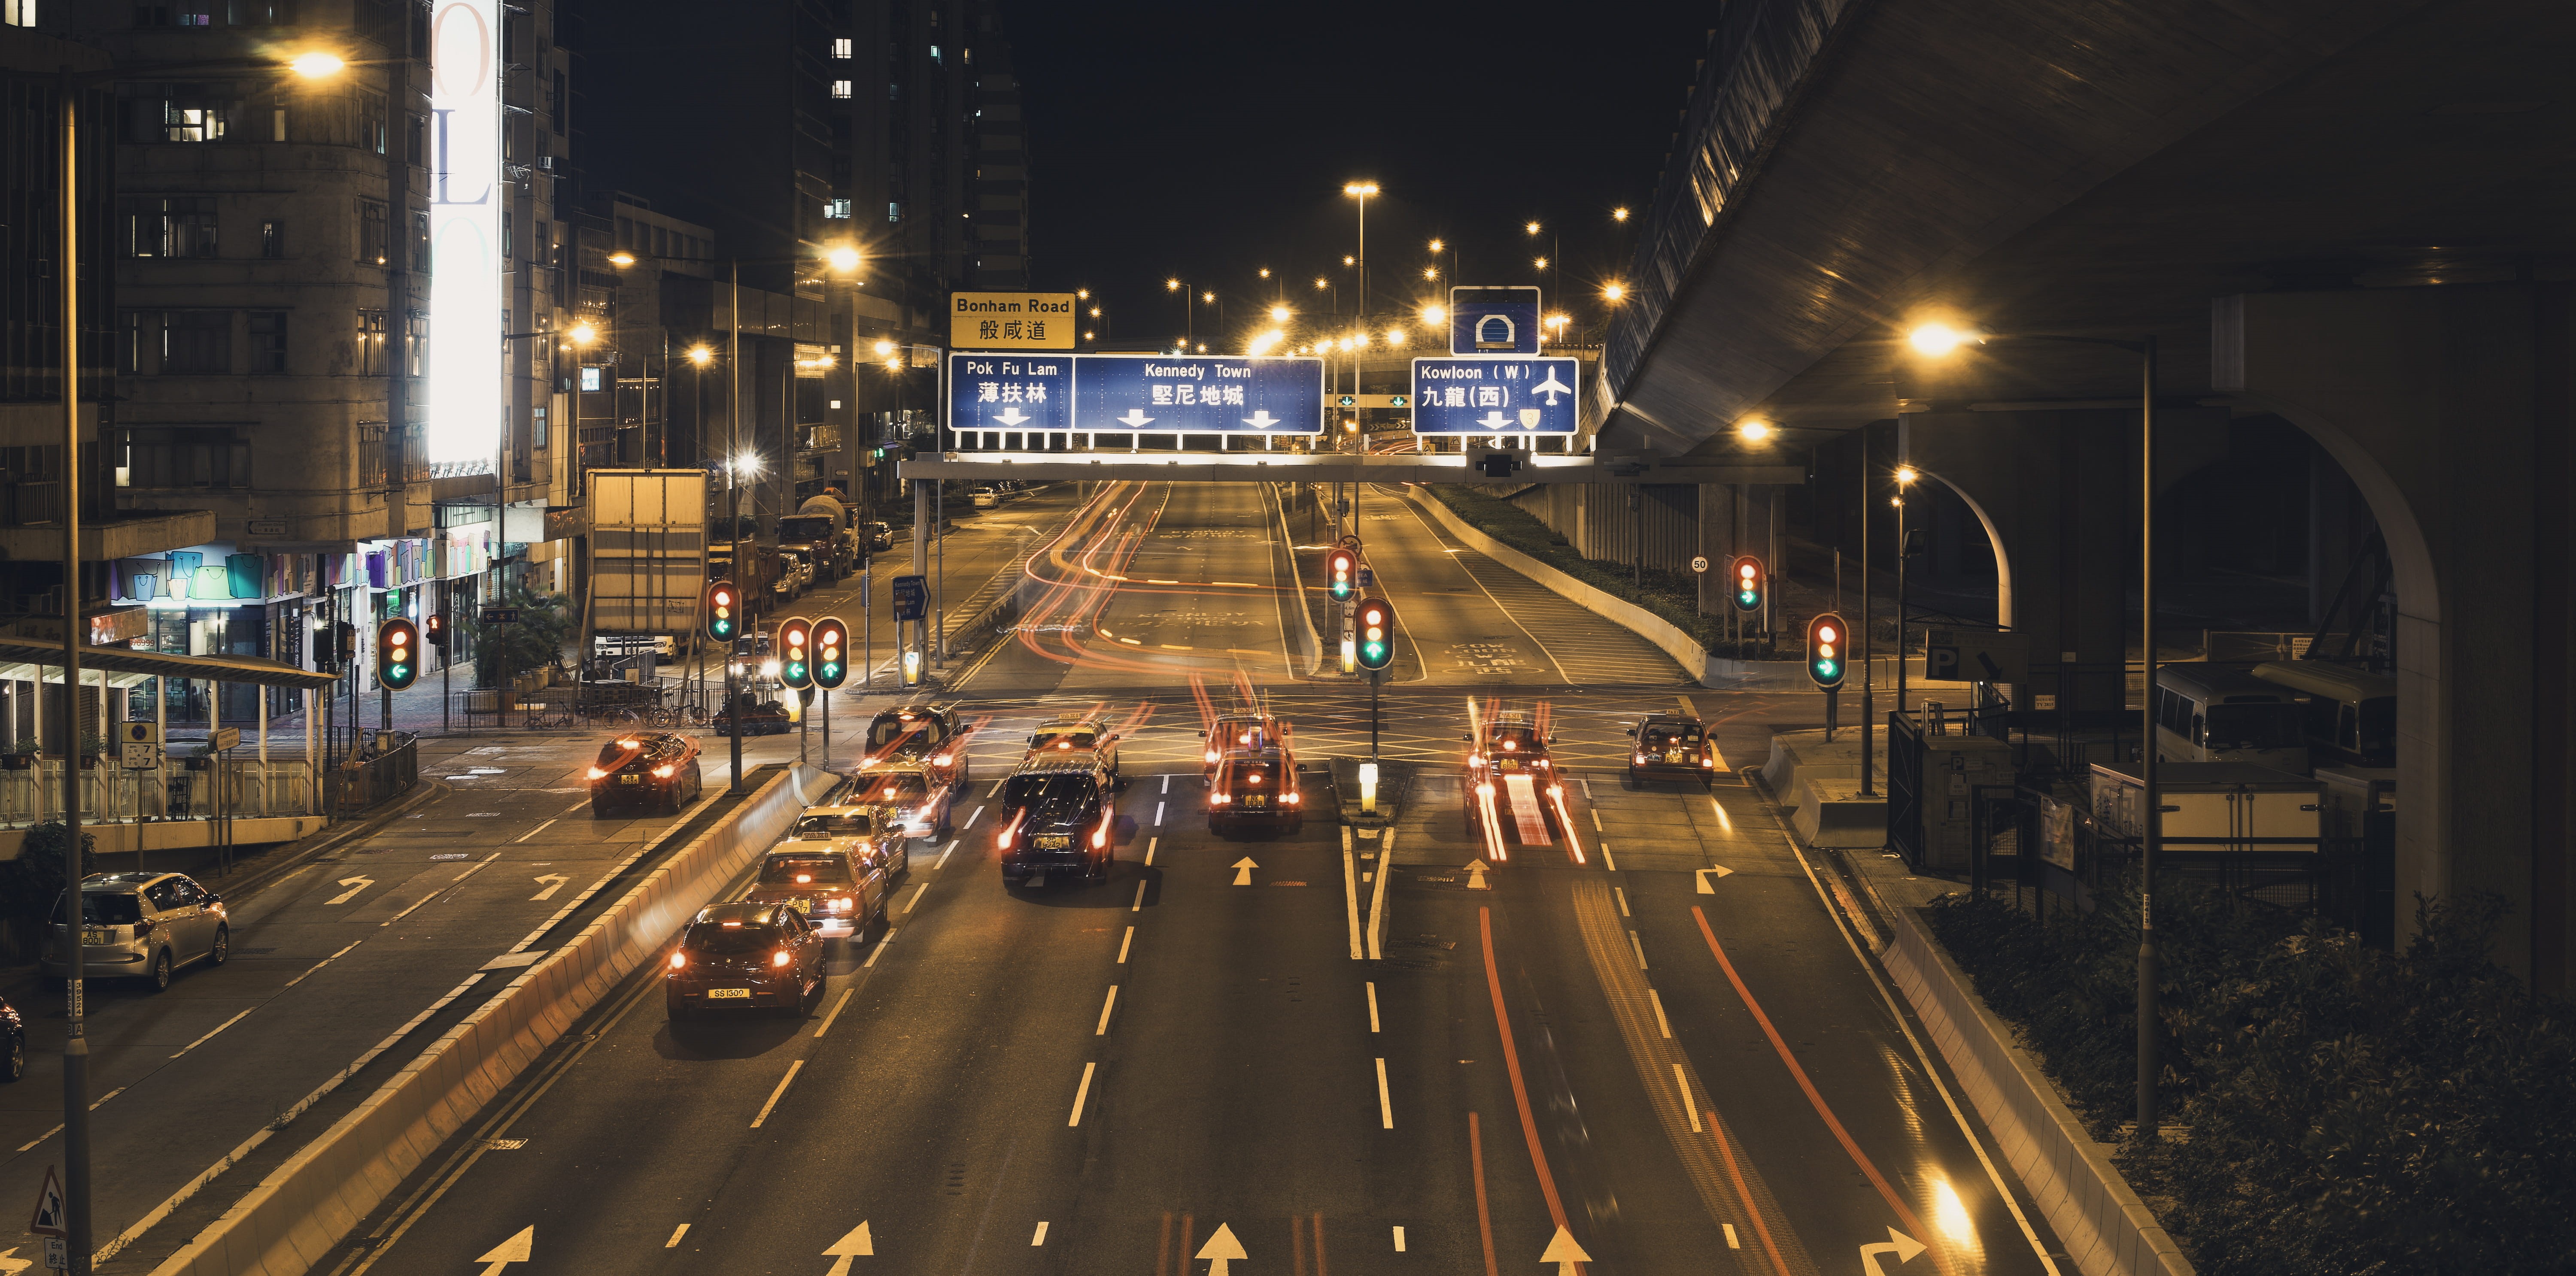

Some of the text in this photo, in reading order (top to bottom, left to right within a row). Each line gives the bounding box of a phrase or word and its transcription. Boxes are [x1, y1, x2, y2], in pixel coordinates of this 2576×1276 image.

[957, 299, 1069, 312] Bonham Road
[980, 320, 1046, 340] 般咸道
[967, 361, 1057, 375] Pok Fu Lam
[1145, 364, 1251, 380] Kennedy Town
[1422, 365, 1482, 379] Kowloon
[978, 382, 1047, 403] 薄扶林
[1152, 384, 1243, 405] 堅尼地城
[1422, 386, 1509, 408] 九龍(西)
[1527, 412, 1534, 425] 3
[1932, 649, 1957, 676] P
[1953, 758, 1963, 769] P
[76, 1024, 82, 1034] A
[52, 1242, 62, 1250] End
[49, 1253, 66, 1265] 終止
